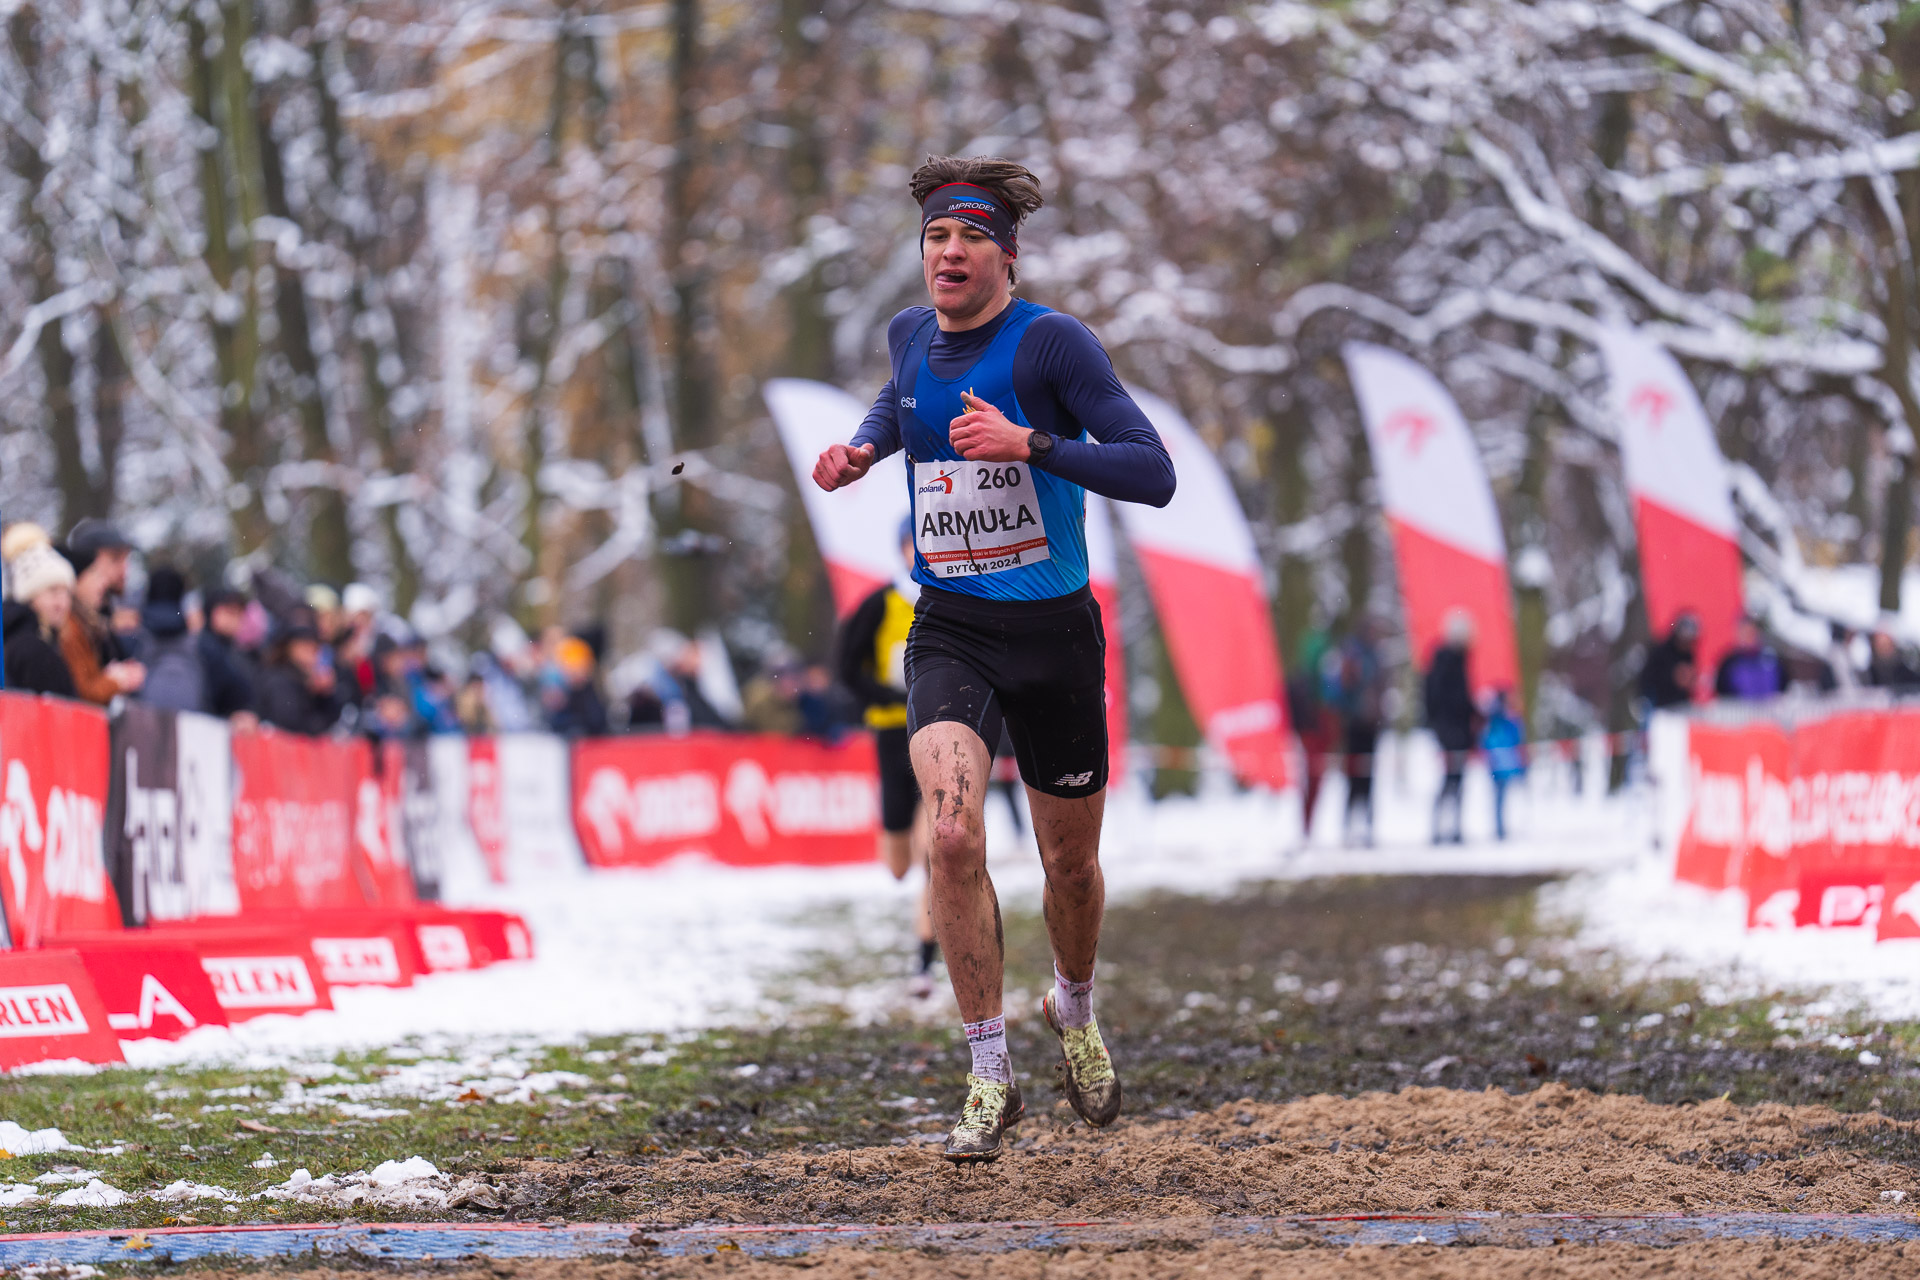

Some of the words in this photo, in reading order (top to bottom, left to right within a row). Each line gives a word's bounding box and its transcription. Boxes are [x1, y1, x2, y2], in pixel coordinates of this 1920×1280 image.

[948, 202, 996, 213] IMPRODEX
[976, 466, 1021, 490] 260
[918, 484, 945, 496] polanik
[920, 504, 1038, 538] ARMUŁA
[971, 550, 984, 558] olski
[990, 557, 1019, 571] 2024
